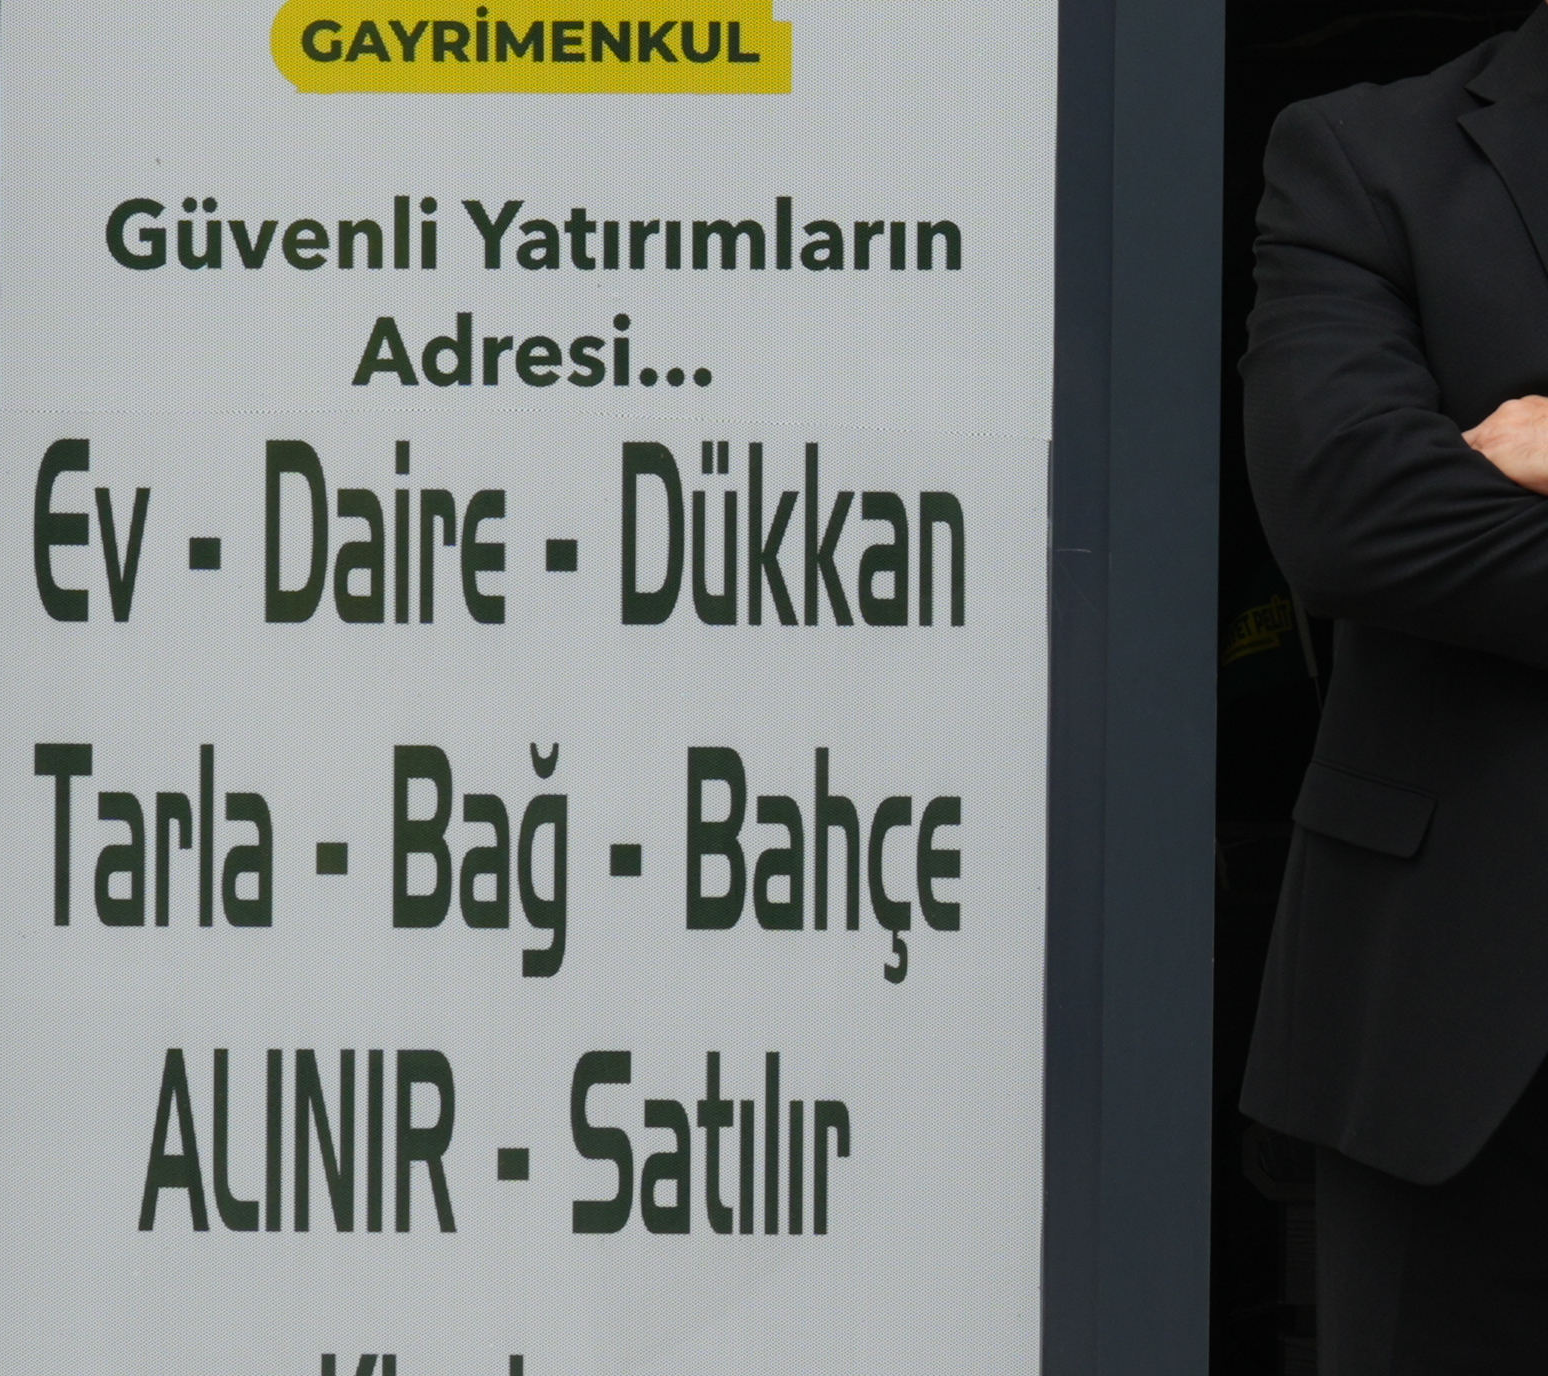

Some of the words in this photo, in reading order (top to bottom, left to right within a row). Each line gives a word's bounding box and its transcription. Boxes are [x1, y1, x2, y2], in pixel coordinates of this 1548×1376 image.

[303, 8, 759, 63] GAYRİMENKUL
[106, 196, 436, 270] Güvenli
[464, 197, 961, 270] Yatırımların
[353, 313, 711, 386] Adresi...
[34, 439, 149, 622] Ev
[266, 441, 505, 624] Daire
[622, 442, 964, 626] Dükkan
[35, 744, 272, 927] Tarla
[393, 744, 567, 977] Bağ
[687, 747, 960, 983] Bahçe
[139, 1049, 455, 1232] ALINIR
[571, 1051, 850, 1234] Satılır
